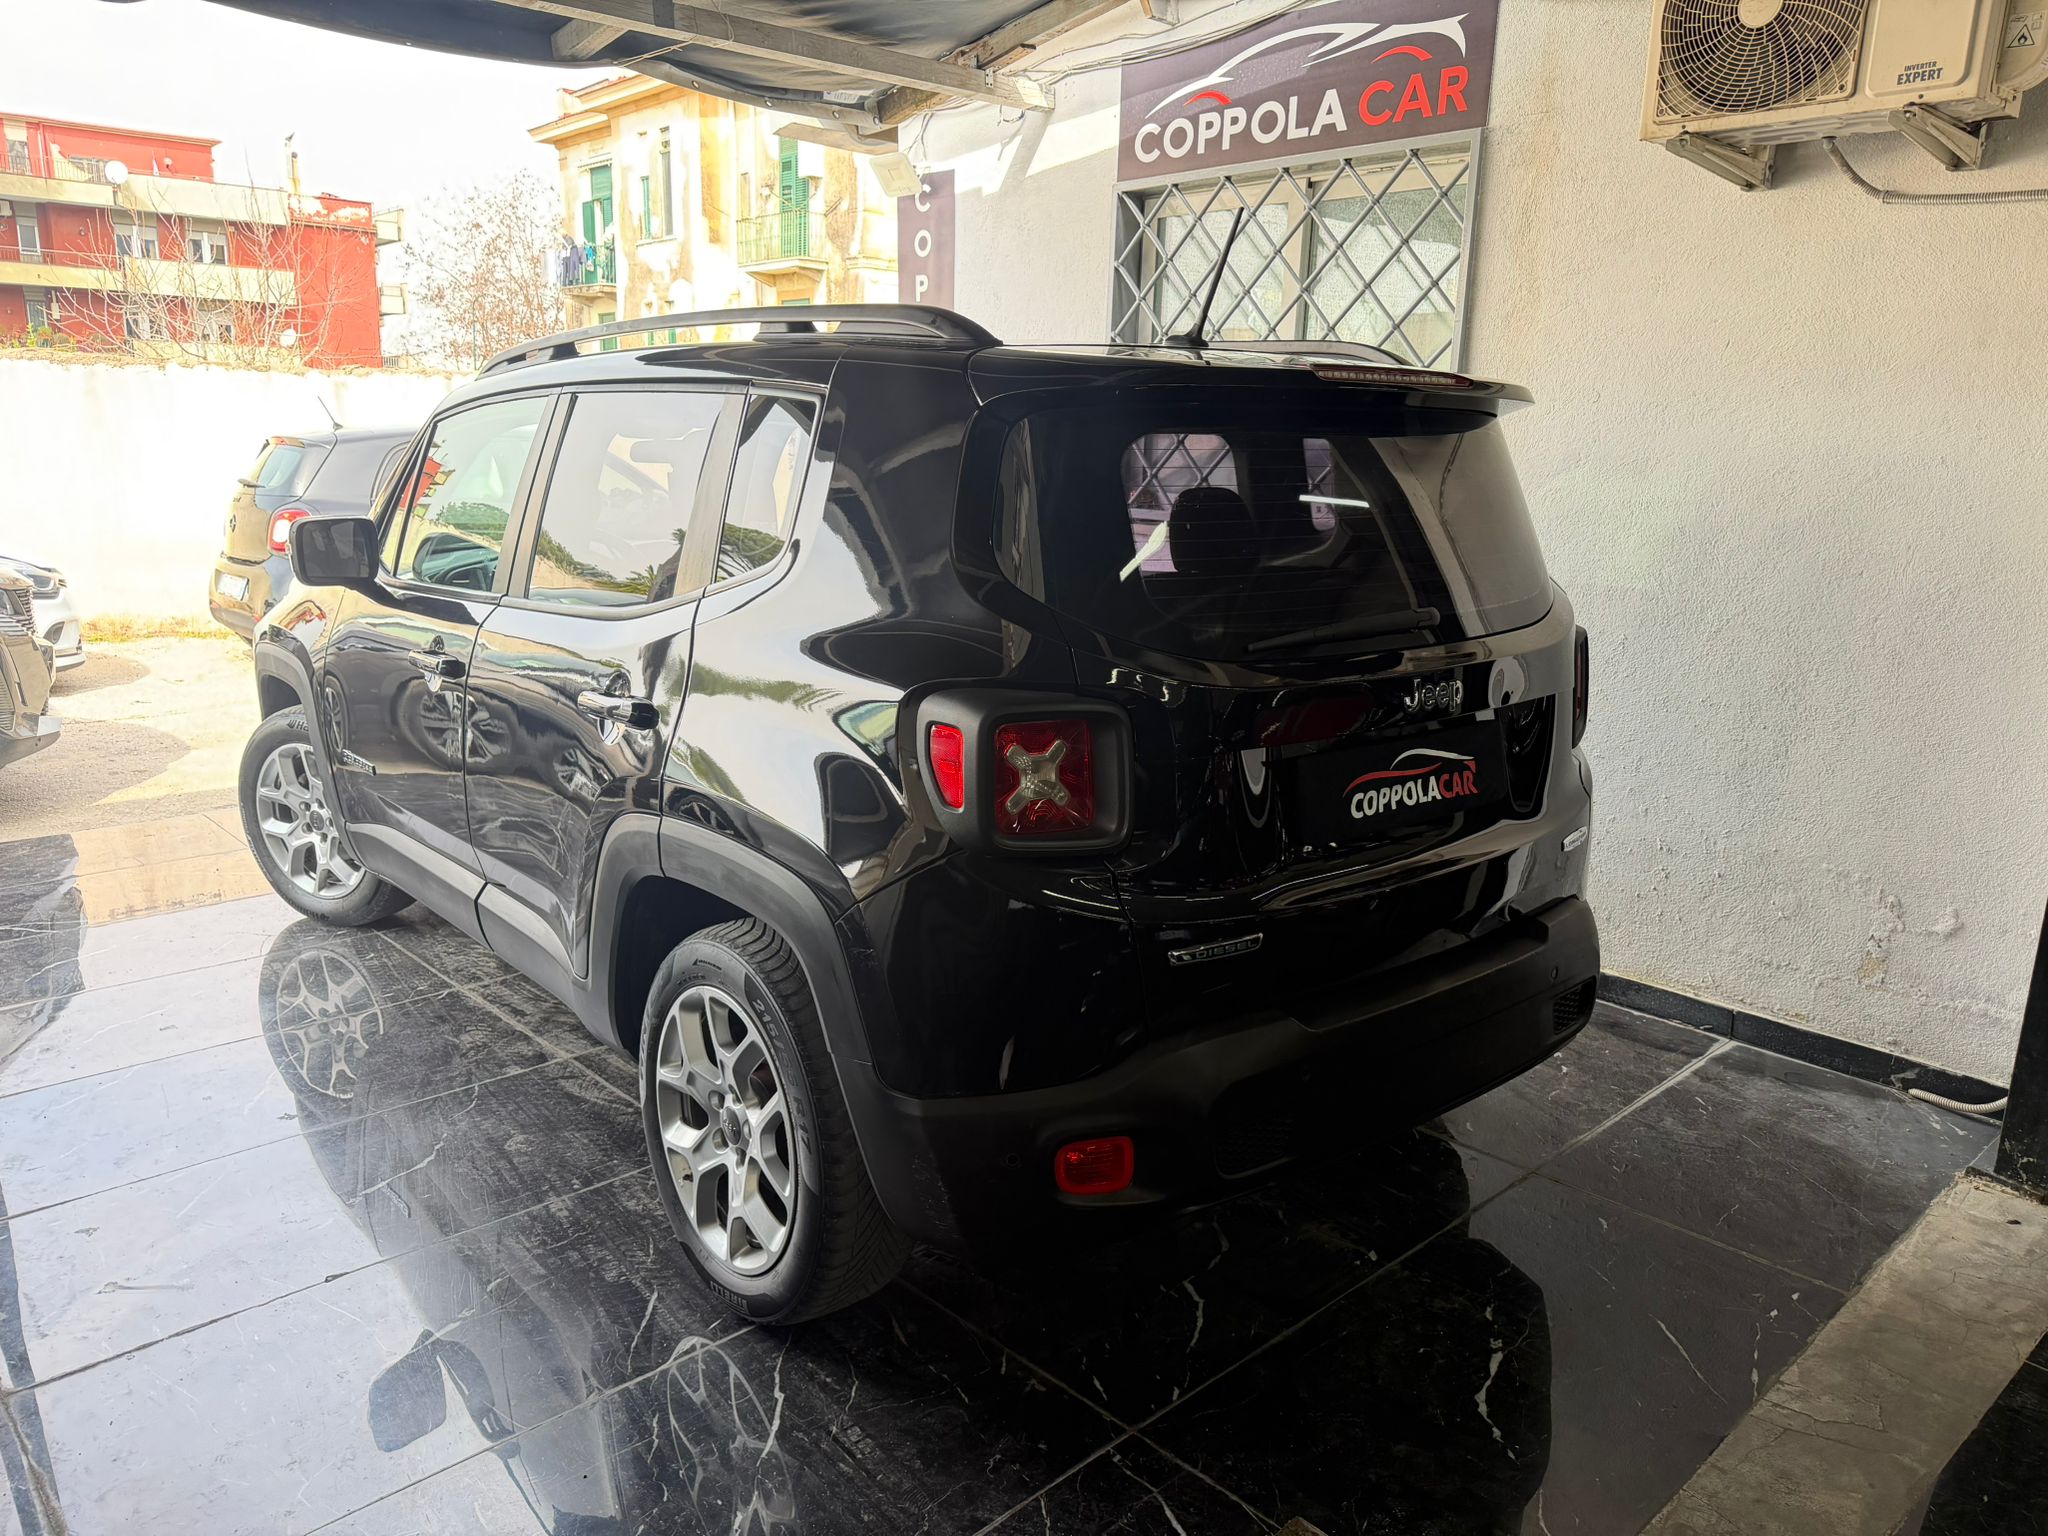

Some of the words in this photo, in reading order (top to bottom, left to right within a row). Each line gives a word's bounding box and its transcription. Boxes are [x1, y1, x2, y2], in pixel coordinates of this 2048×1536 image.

[1903, 60, 1938, 72] INVERTER
[1896, 67, 1944, 86] EXPERT
[1134, 88, 1347, 164] COPPOLA
[1358, 65, 1469, 126] CAR
[1404, 679, 1463, 711] Jeep
[1196, 941, 1257, 959] DIESEL
